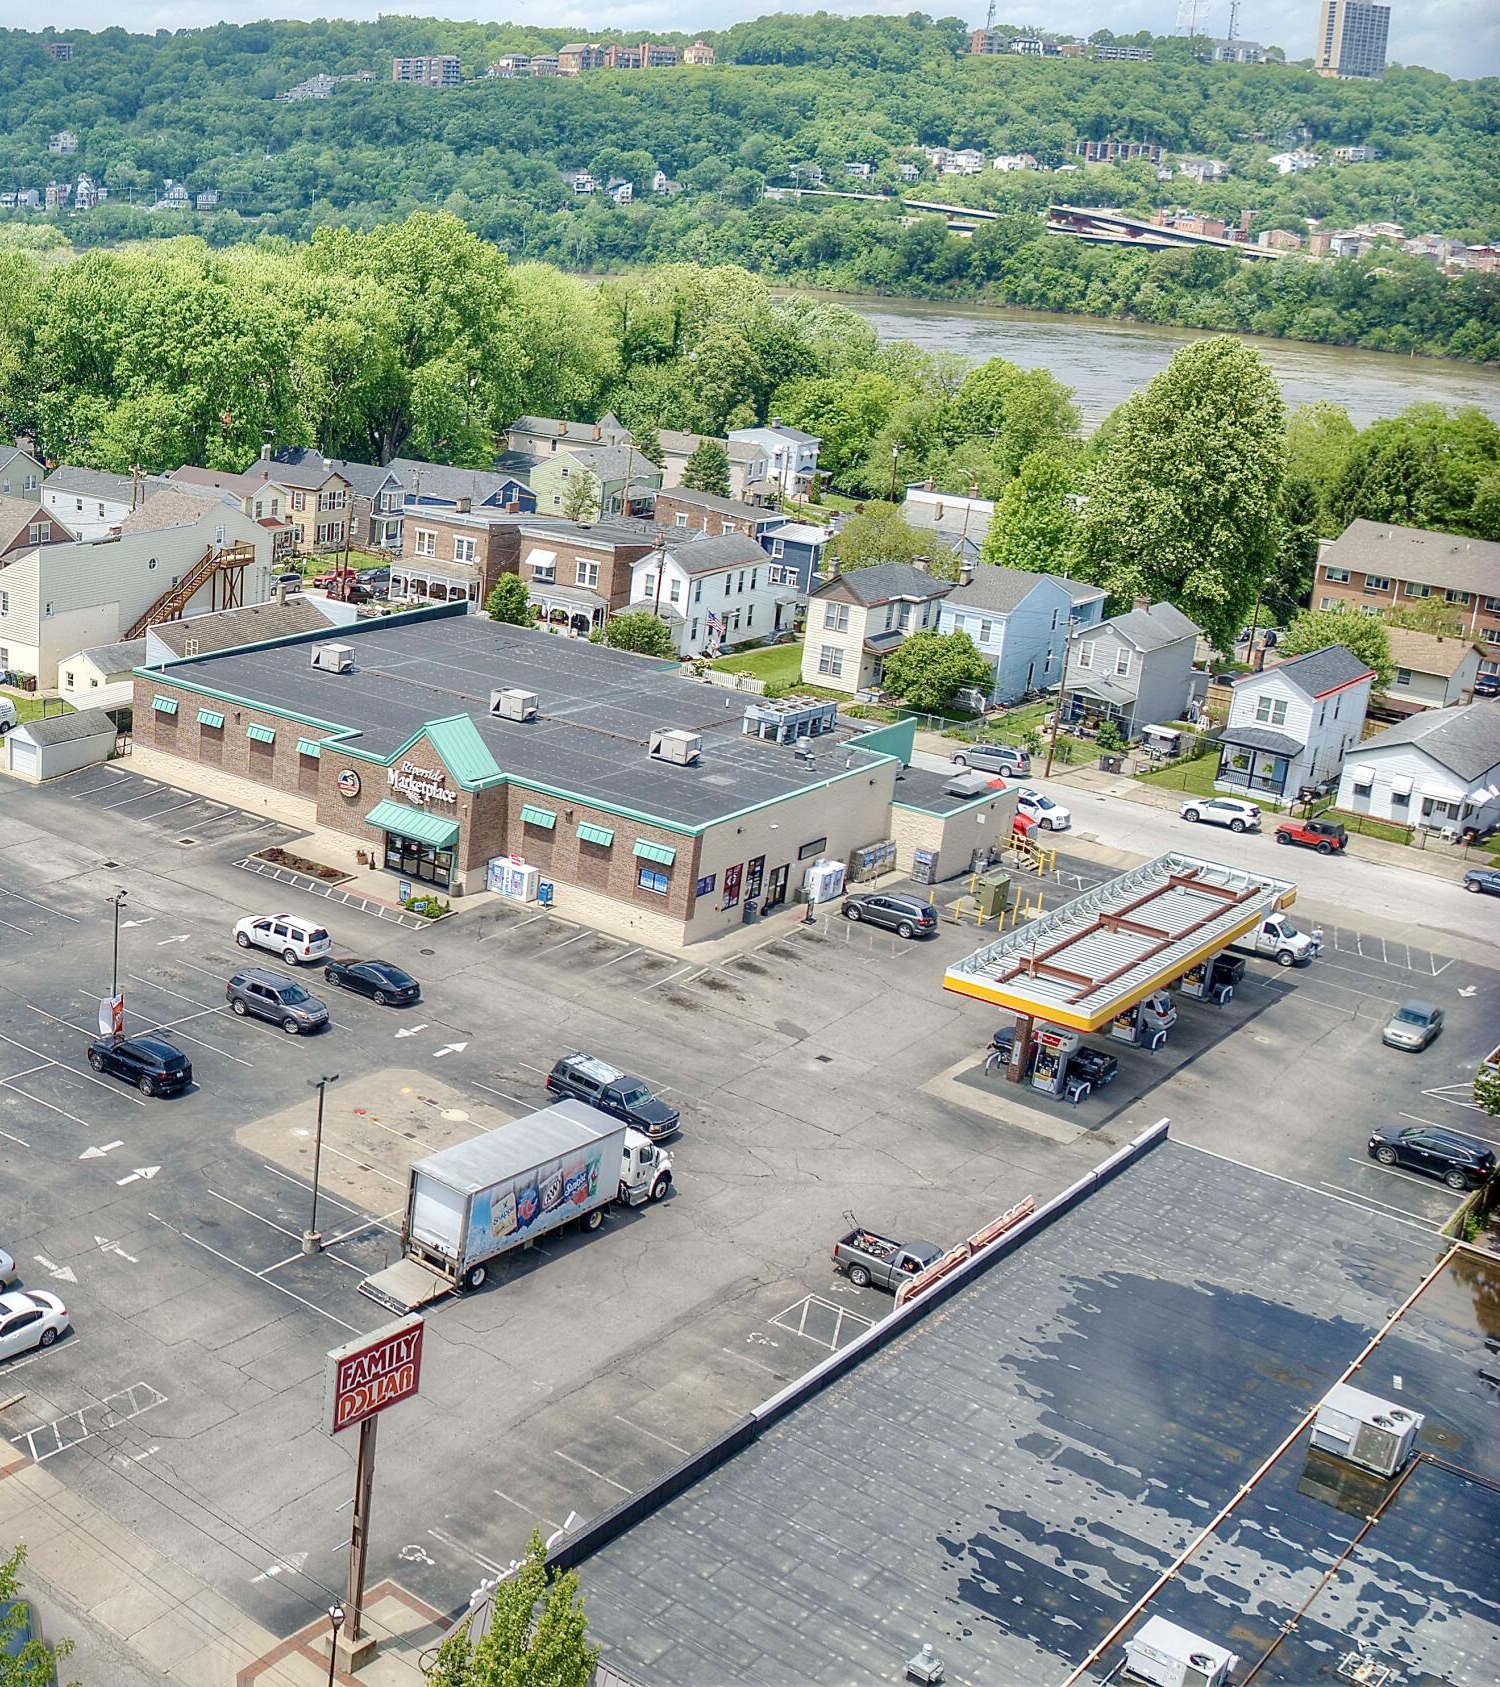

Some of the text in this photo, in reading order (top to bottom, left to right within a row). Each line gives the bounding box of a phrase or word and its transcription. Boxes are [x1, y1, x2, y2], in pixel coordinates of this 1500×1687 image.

[387, 767, 456, 803] Marketplace
[402, 760, 444, 782] Riverside
[340, 1330, 420, 1394] FAMILY
[338, 1364, 414, 1424] DOLLAR
